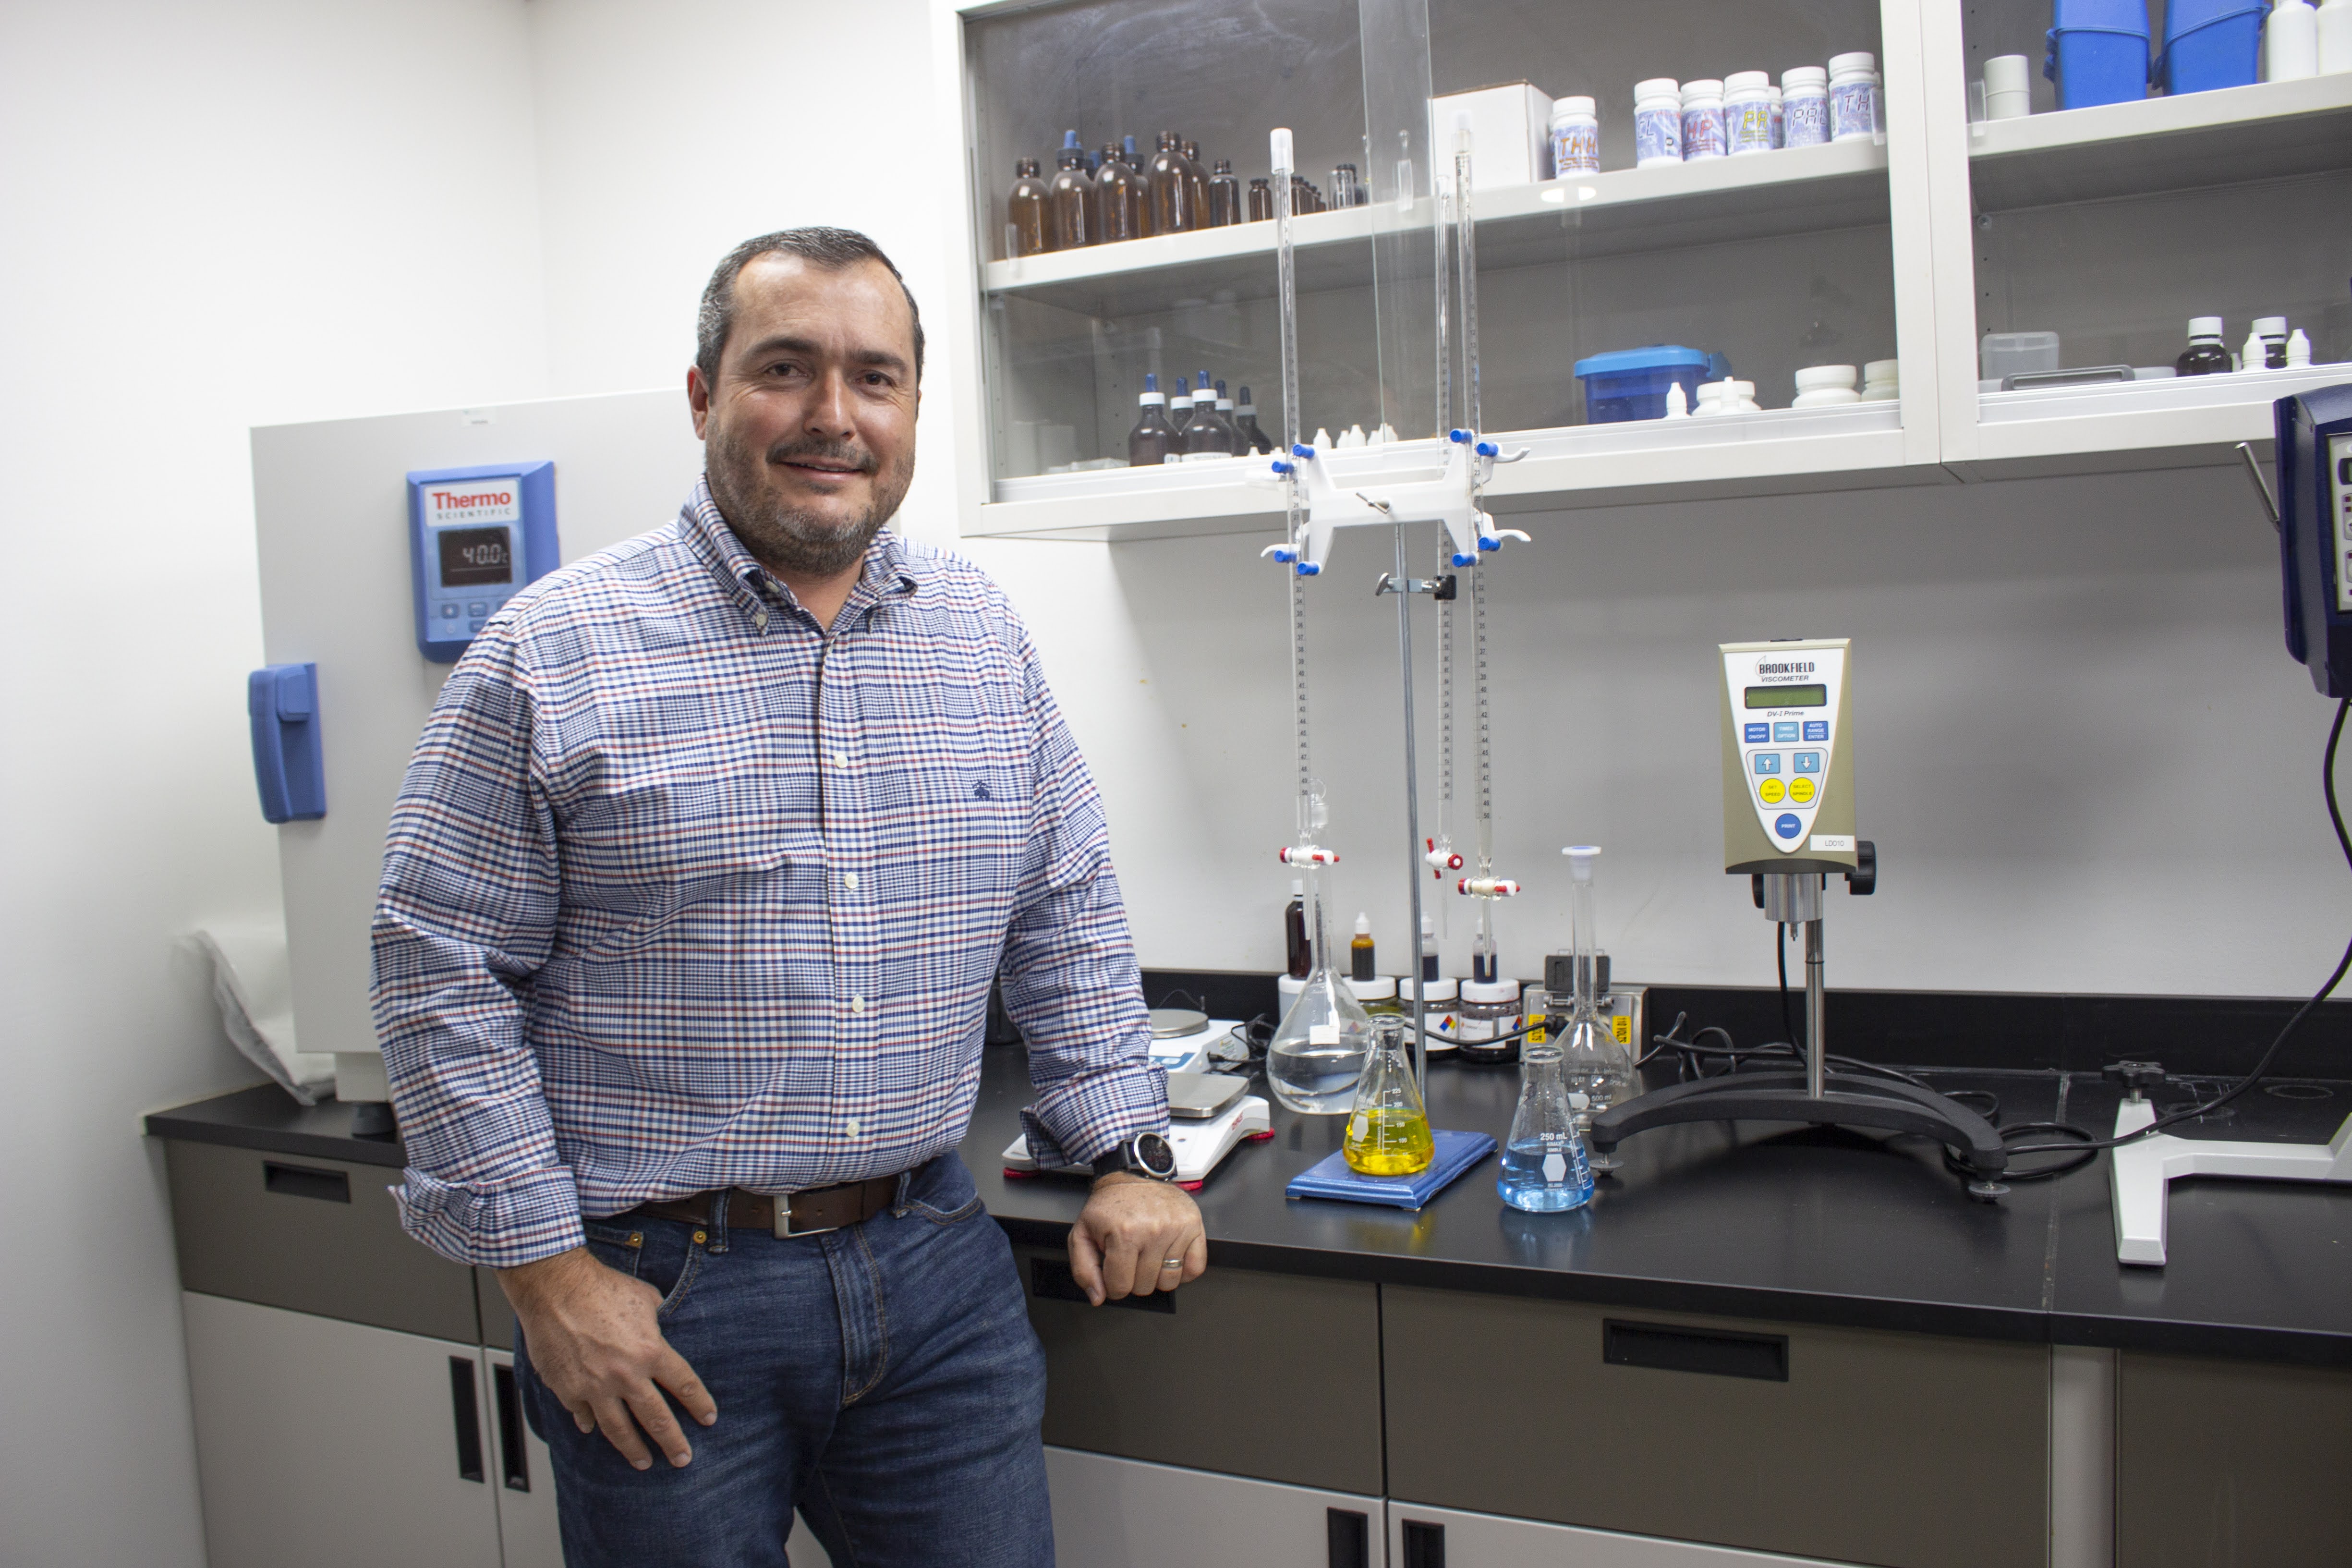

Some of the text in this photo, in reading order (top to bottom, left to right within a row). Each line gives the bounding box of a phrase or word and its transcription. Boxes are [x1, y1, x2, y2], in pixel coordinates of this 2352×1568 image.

[1686, 120, 1713, 140] HP
[432, 492, 511, 510] Thermo
[436, 508, 511, 519] SCIENTIFIC
[1759, 662, 1815, 674] BROOKFIELD
[1540, 1131, 1568, 1141] 250 mL
